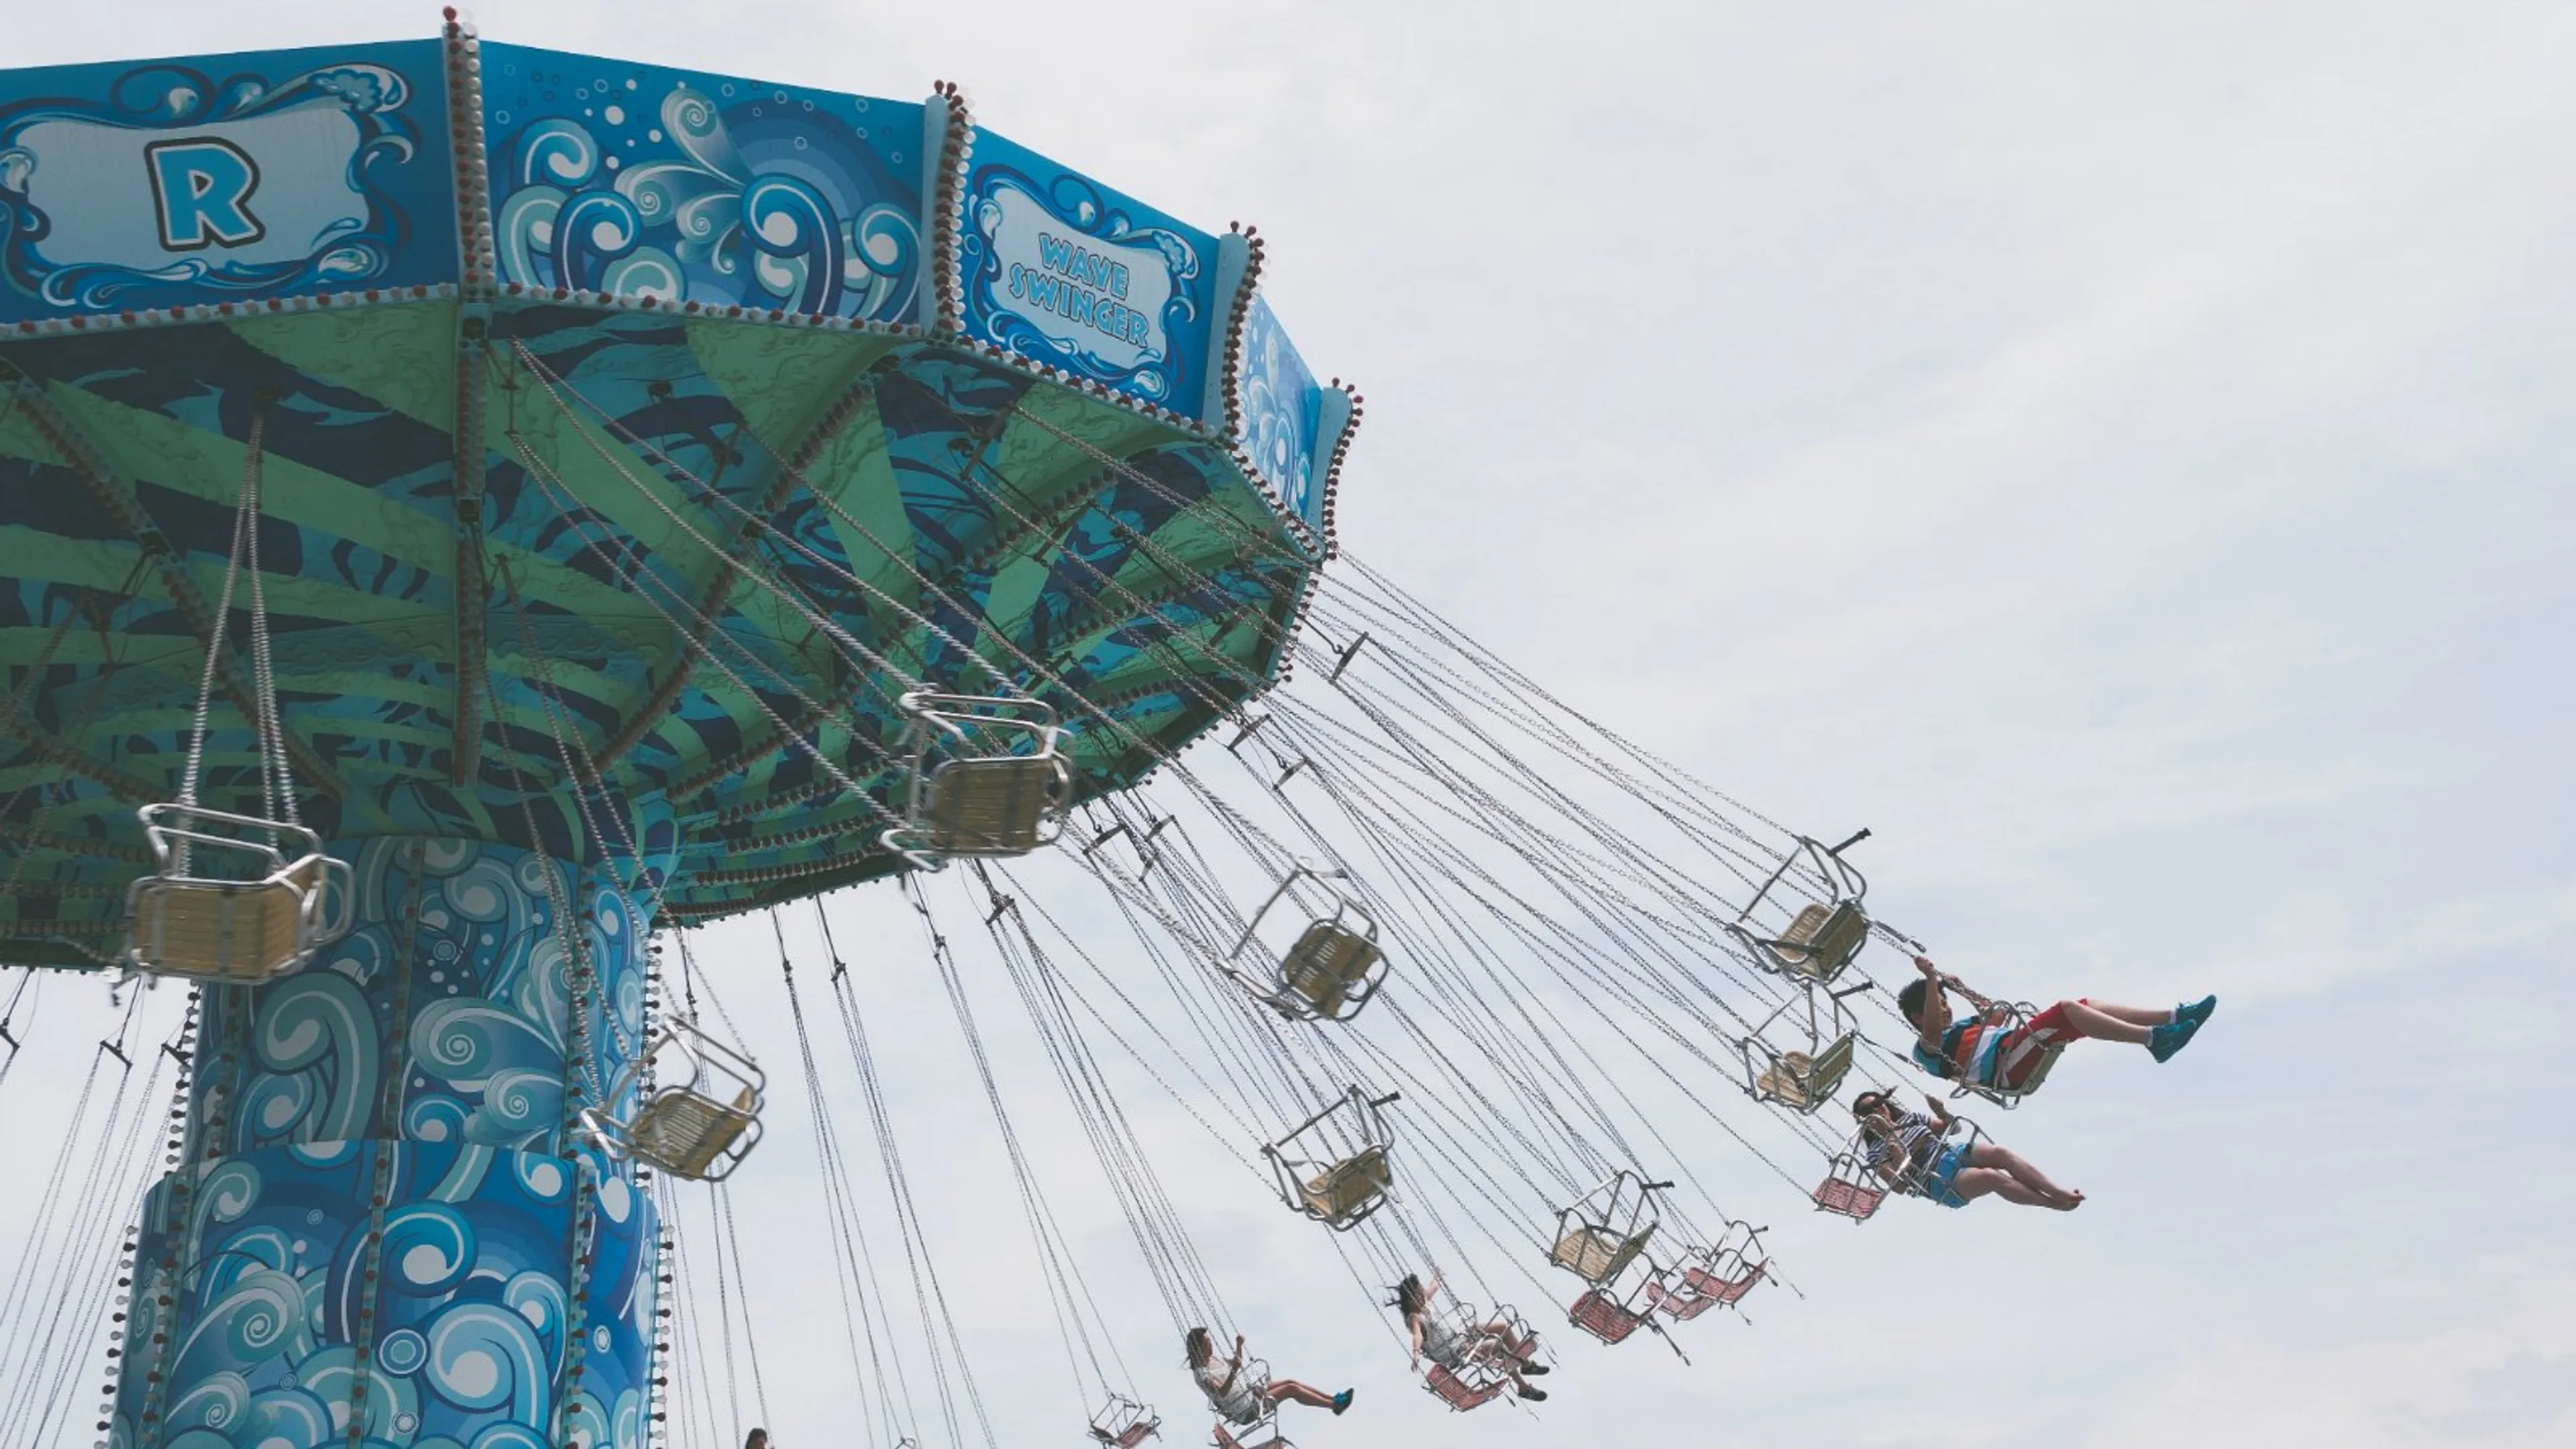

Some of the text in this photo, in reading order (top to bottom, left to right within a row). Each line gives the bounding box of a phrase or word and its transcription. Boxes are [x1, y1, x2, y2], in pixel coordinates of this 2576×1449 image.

[144, 136, 266, 252] R
[1009, 263, 1149, 347] SWINGER
[1038, 232, 1128, 301] WAVE
